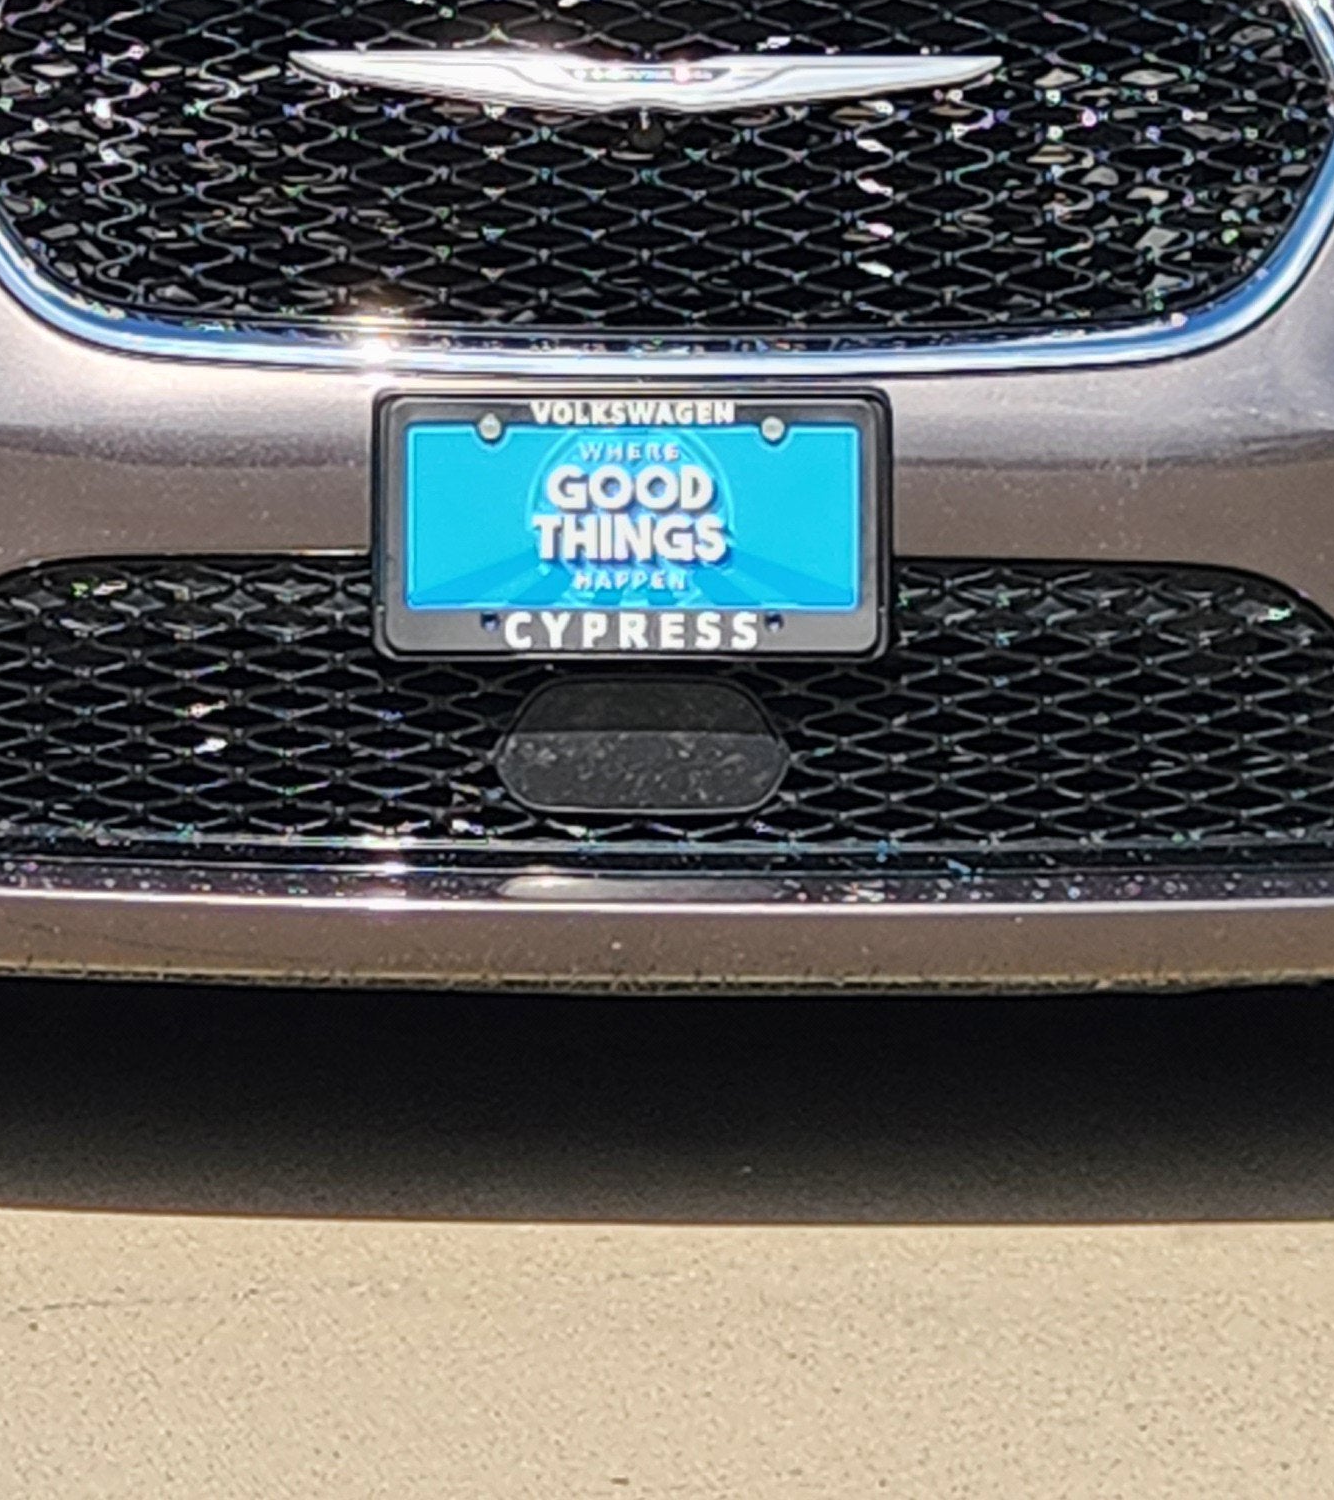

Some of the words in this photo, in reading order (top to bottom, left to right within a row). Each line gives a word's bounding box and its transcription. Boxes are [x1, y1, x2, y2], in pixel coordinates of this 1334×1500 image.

[529, 401, 736, 425] VOLKSWAGEN
[578, 441, 681, 462] WHERE
[546, 464, 715, 511] GOOD
[532, 514, 727, 562] THINGS
[573, 570, 686, 591] HAPPEN
[504, 610, 759, 650] CYPRESS
